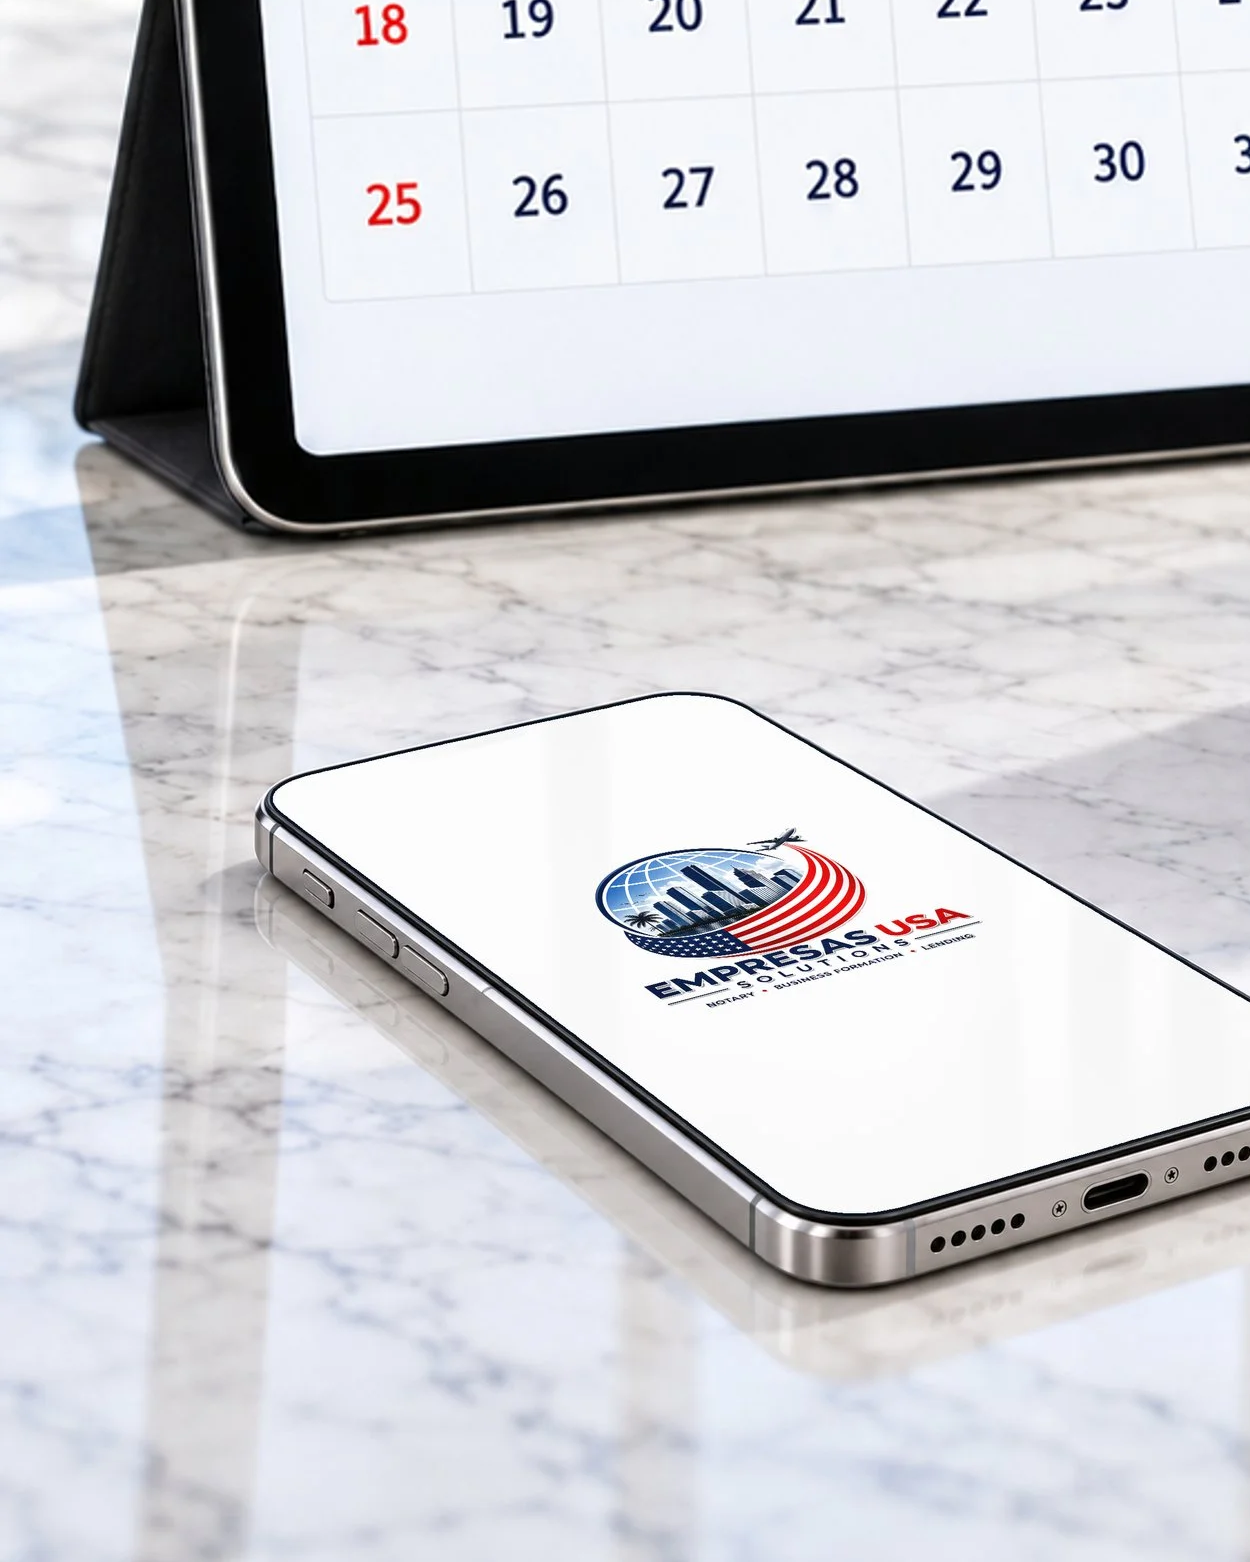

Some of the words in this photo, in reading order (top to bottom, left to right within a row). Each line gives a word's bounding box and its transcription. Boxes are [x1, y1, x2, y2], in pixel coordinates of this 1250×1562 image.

[354, 3, 409, 47] 18
[366, 181, 422, 227] 25
[512, 173, 569, 218] 26
[661, 165, 715, 210] 27
[805, 157, 859, 201] 28
[950, 149, 1002, 193] 29
[1093, 140, 1146, 183] 30
[644, 929, 877, 999] EMPRESAS
[875, 908, 971, 937] USA
[706, 991, 755, 1008] NOTARY
[774, 972, 832, 990] BUSINESS
[833, 952, 904, 974] FORMATION
[921, 933, 976, 951] LENDING
[737, 939, 909, 989] SOLUTIONS
